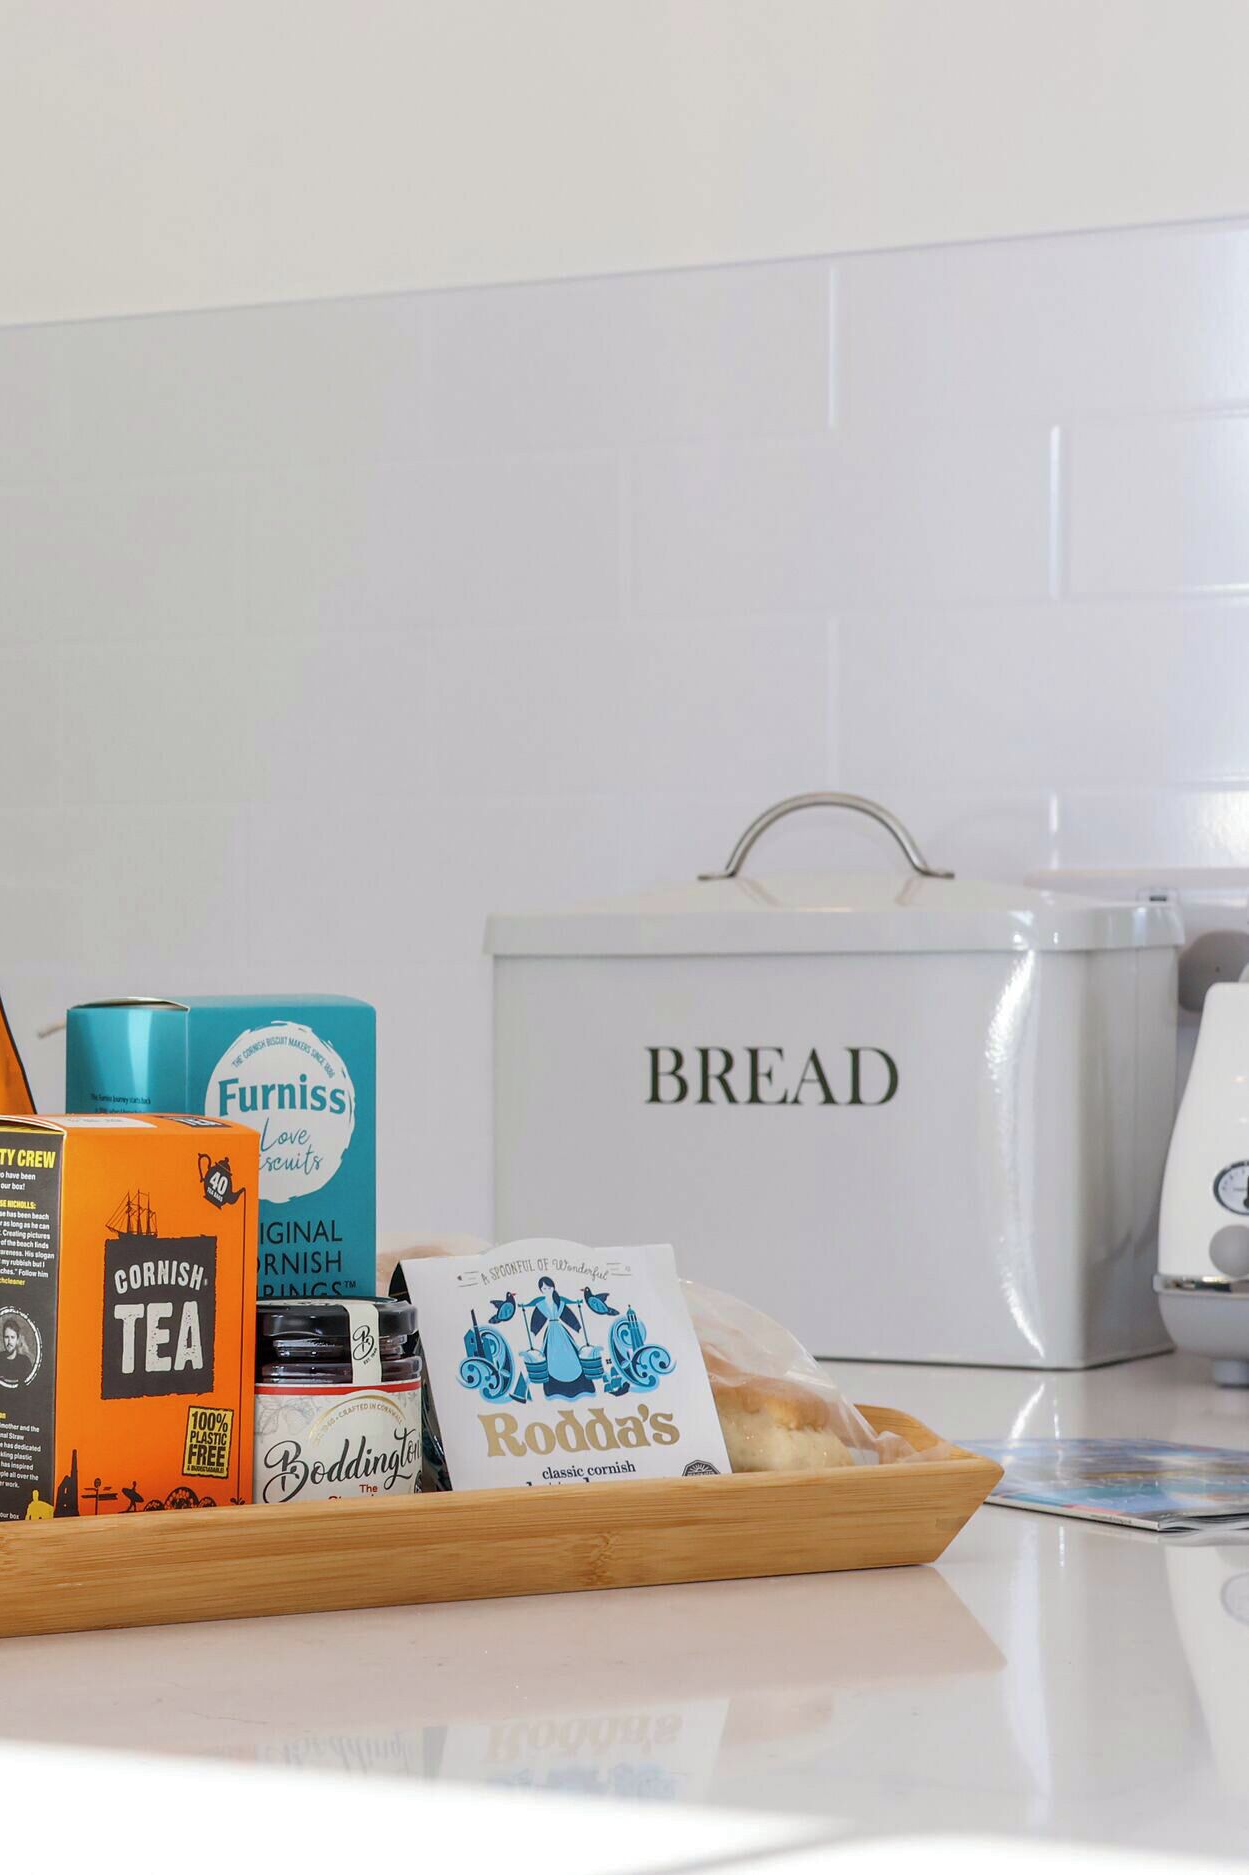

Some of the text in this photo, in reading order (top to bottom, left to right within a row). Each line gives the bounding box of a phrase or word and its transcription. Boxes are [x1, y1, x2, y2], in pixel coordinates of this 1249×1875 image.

[243, 1040, 266, 1058] CORNISH
[266, 1036, 288, 1047] BISCUIT
[288, 1038, 311, 1054] MAKERS
[311, 1049, 325, 1066] SINCE
[645, 1046, 899, 1105] BREAD
[218, 1073, 346, 1117] Furniss
[261, 1117, 311, 1152] Love
[17, 1150, 56, 1168] CREW
[5, 1172, 20, 1180] have
[21, 1172, 36, 1180] been
[12, 1182, 25, 1190] box!
[210, 1172, 228, 1195] 40
[11, 1221, 23, 1229] long
[18, 1211, 31, 1219] been
[32, 1212, 49, 1220] beach
[3, 1229, 26, 1239] Creating
[260, 1220, 343, 1245] IGINAL
[35, 1251, 54, 1259] slogan
[257, 1251, 341, 1276] RNISH
[18, 1269, 37, 1277] Follow
[114, 1260, 204, 1294] CORNISH
[481, 1258, 608, 1285] A SPOONFUL OF Wonderful
[114, 1301, 203, 1374] TEA
[339, 1403, 368, 1417] CRAFTED
[192, 1411, 228, 1432] 100%
[477, 1403, 680, 1458] Rodda's
[14, 1443, 41, 1452] dedicated
[190, 1431, 227, 1445] PLASTIC
[188, 1444, 226, 1467] FREE
[11, 1462, 34, 1471] inspired
[542, 1460, 636, 1480] classic cornish
[359, 1484, 378, 1493] The
